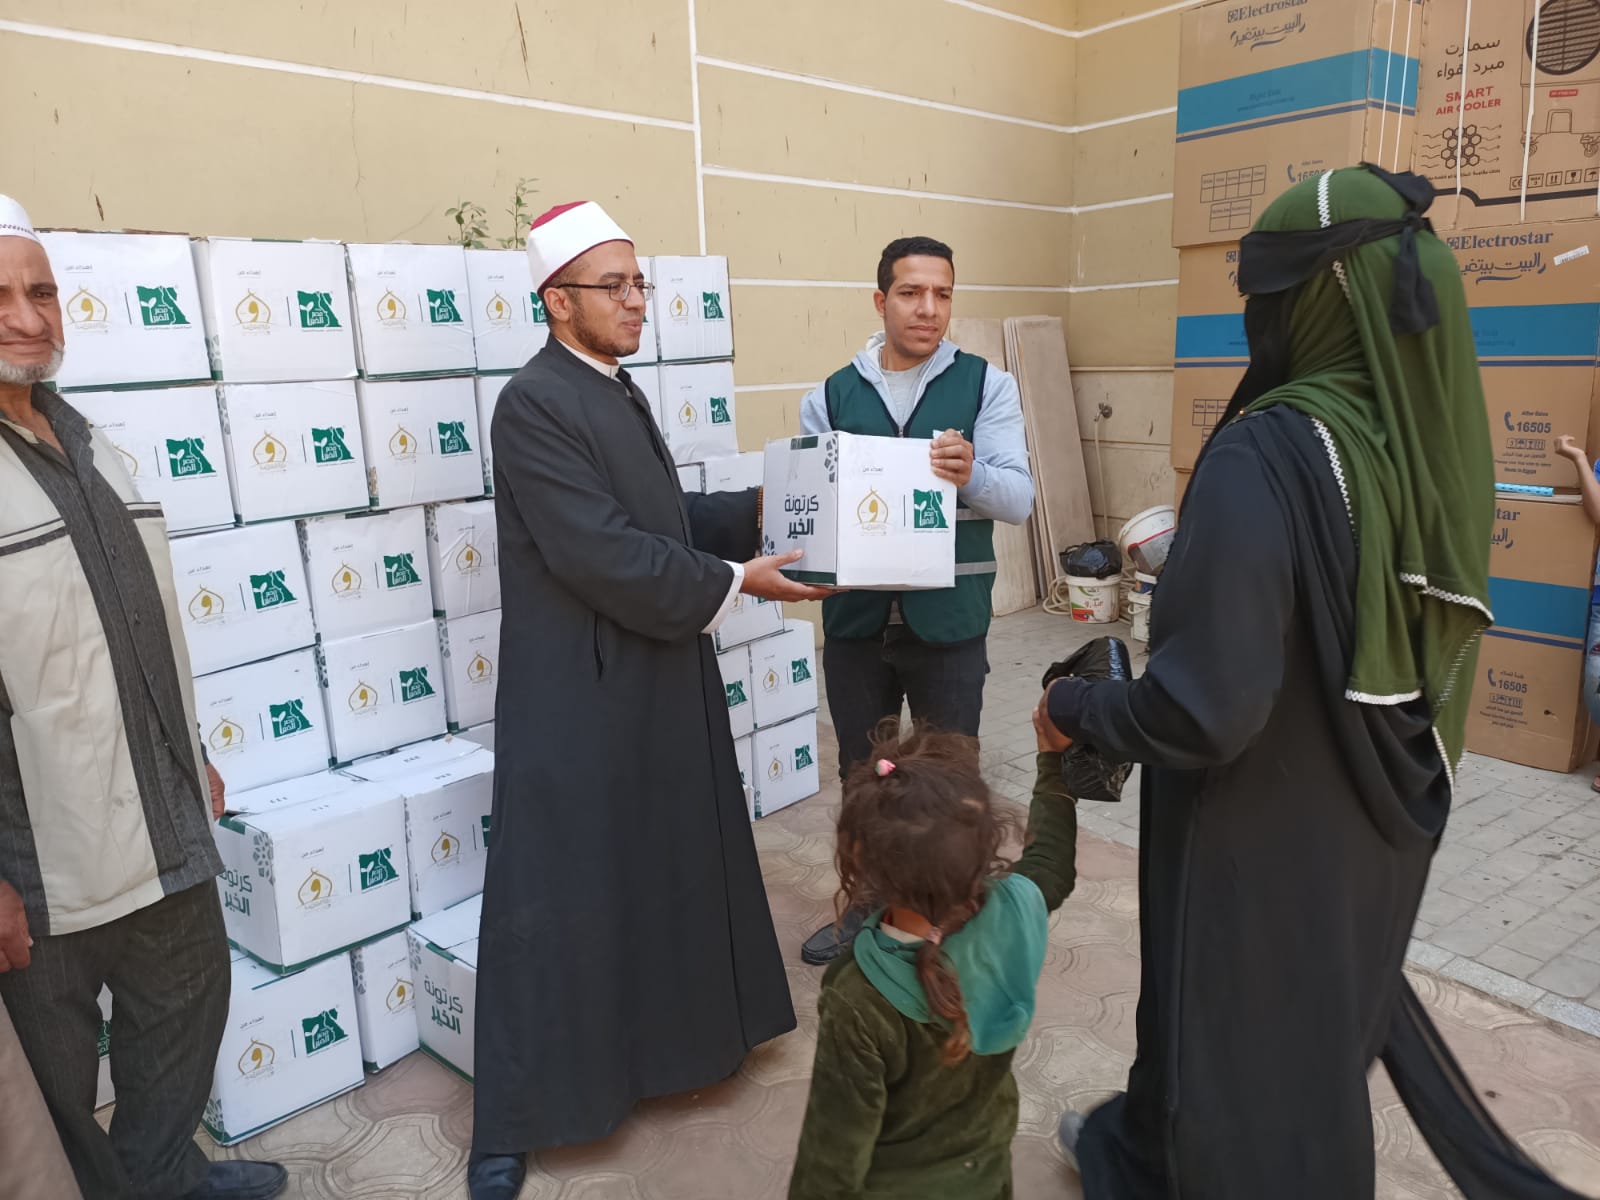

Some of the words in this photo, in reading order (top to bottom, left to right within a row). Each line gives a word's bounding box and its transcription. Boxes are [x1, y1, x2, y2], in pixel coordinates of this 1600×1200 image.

[1473, 61, 1504, 75] مبرد
[1436, 105, 1454, 115] AIR
[1460, 232, 1554, 249] Electrostar
[1517, 421, 1552, 433] 16505
[785, 494, 819, 515] كرتونة
[787, 518, 814, 539] الخير
[1498, 679, 1528, 694] 16505
[225, 891, 250, 916] الخير
[424, 975, 463, 1013] كرتونة
[432, 1005, 461, 1034] الخير
